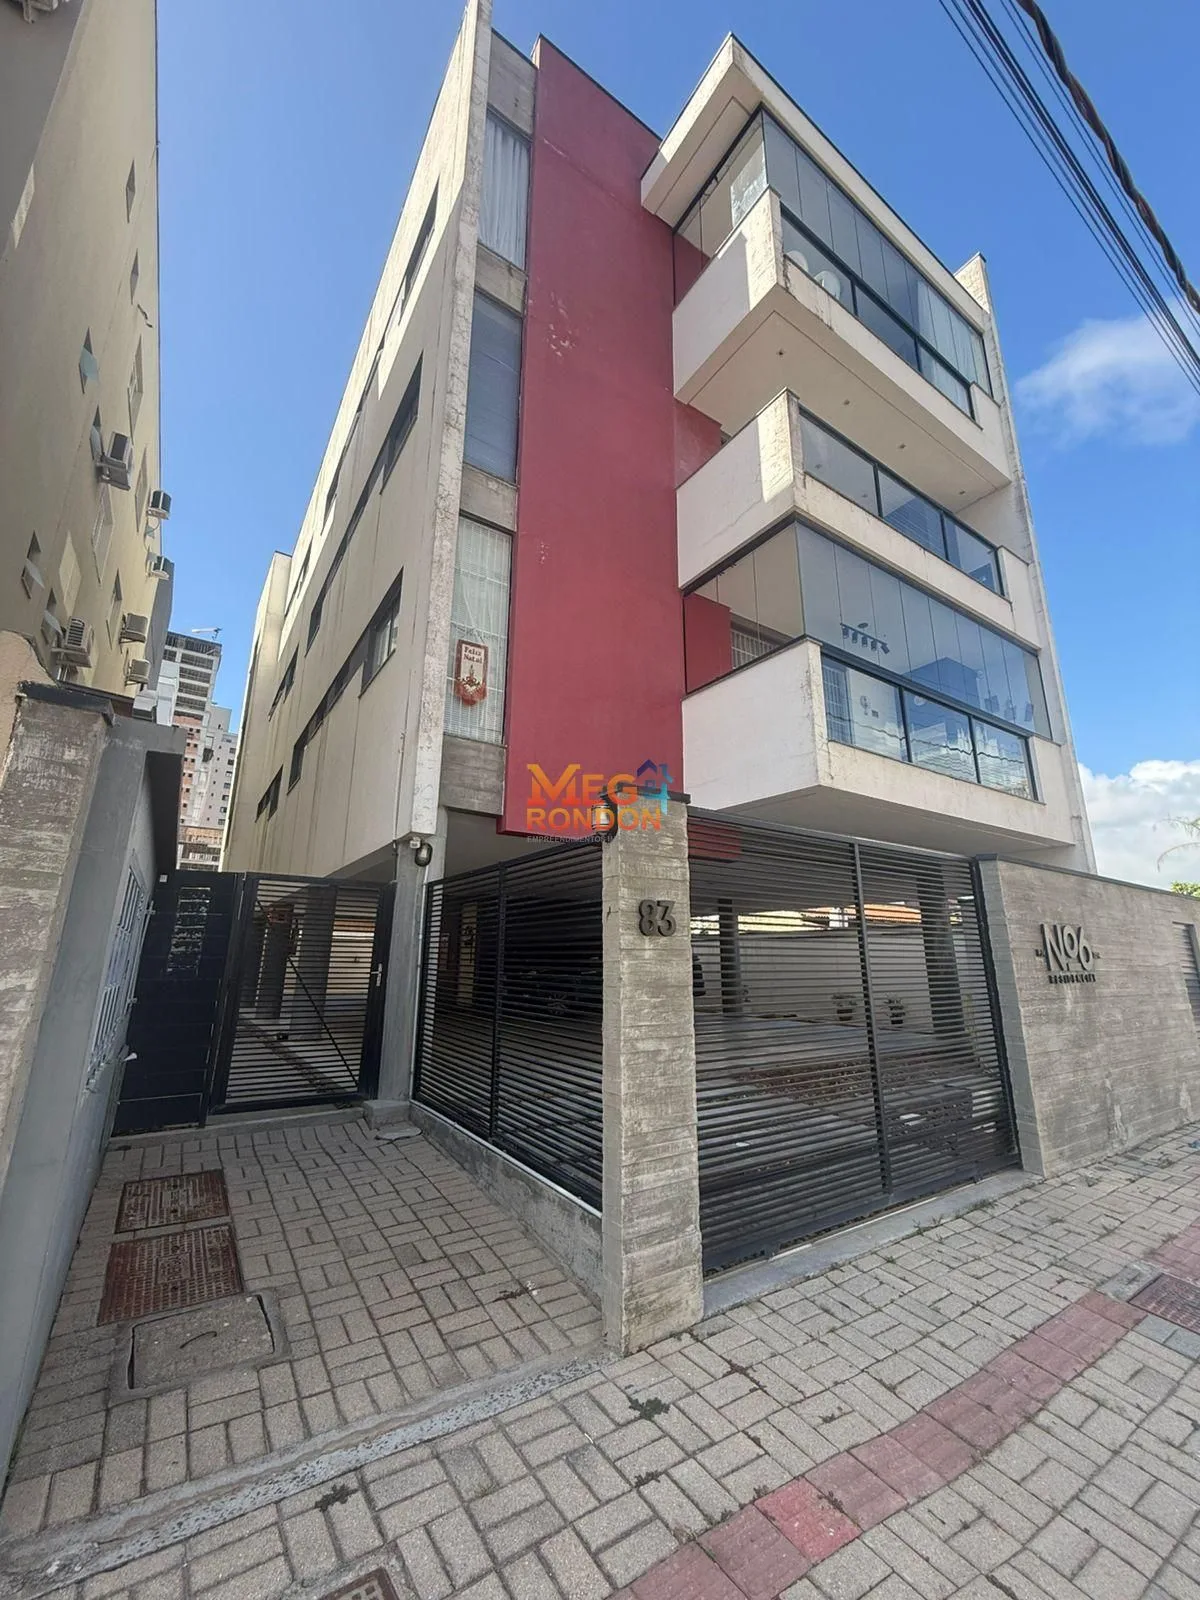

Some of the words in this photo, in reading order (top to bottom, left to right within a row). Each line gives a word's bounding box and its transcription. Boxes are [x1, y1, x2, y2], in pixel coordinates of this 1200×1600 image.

[464, 645, 482, 657] Feliz
[463, 653, 483, 664] Natal
[638, 899, 677, 937] 83
